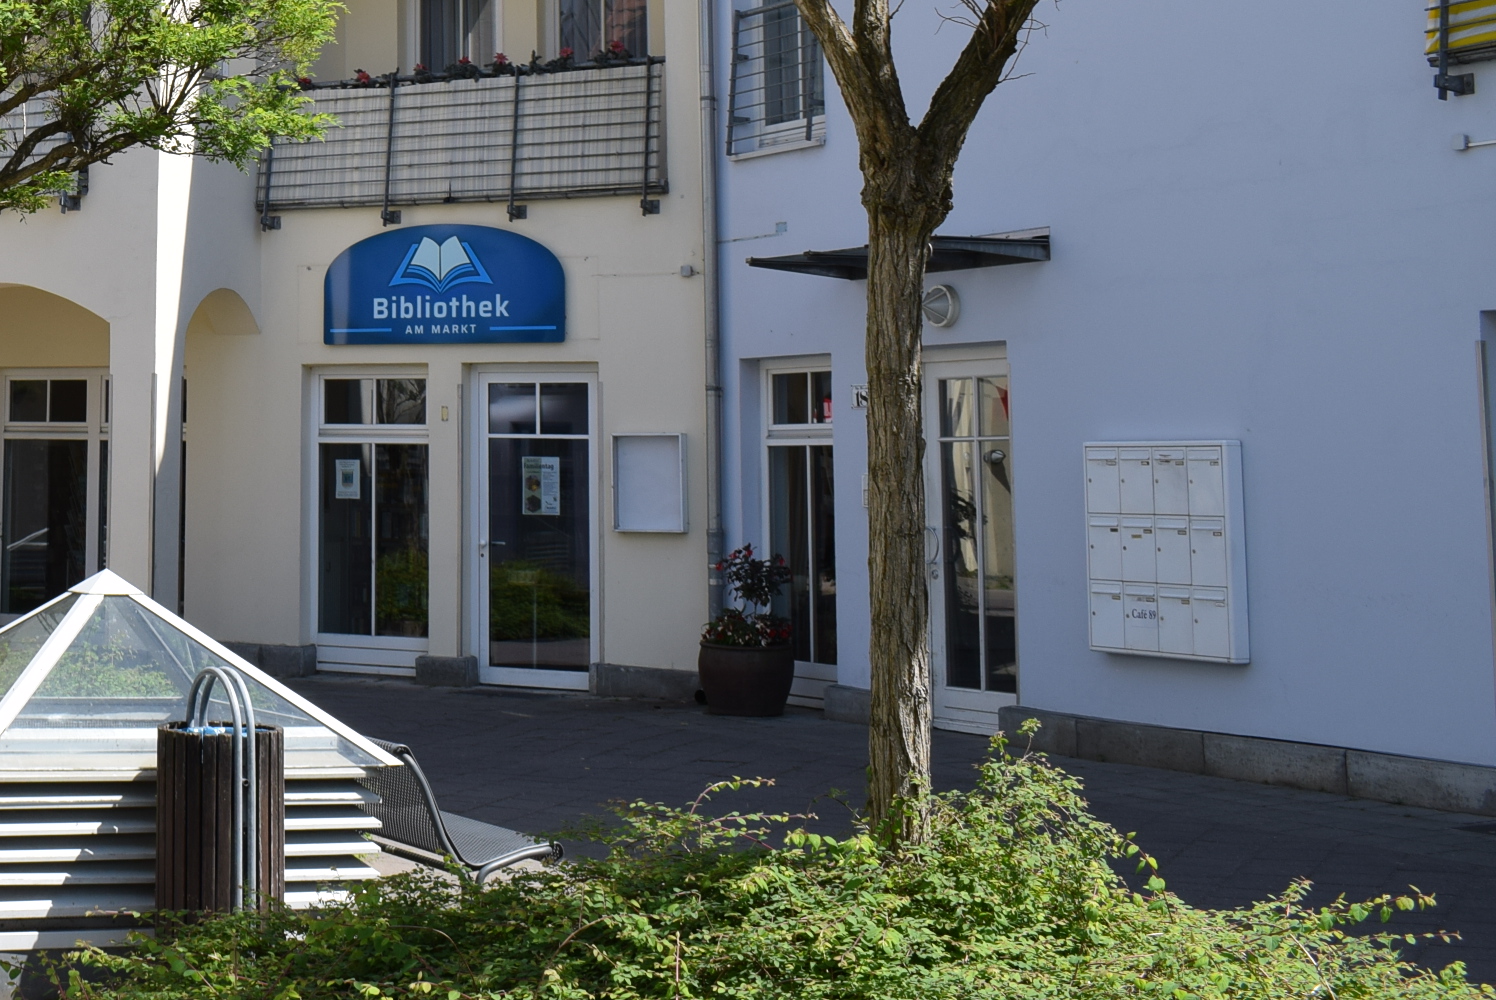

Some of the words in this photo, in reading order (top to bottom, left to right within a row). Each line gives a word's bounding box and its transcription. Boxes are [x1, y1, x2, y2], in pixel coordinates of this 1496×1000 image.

[373, 294, 510, 319] Bibliothek
[405, 325, 424, 335] AM
[431, 324, 477, 334] MARKT
[1131, 608, 1147, 619] Café
[1149, 610, 1156, 620] 89
